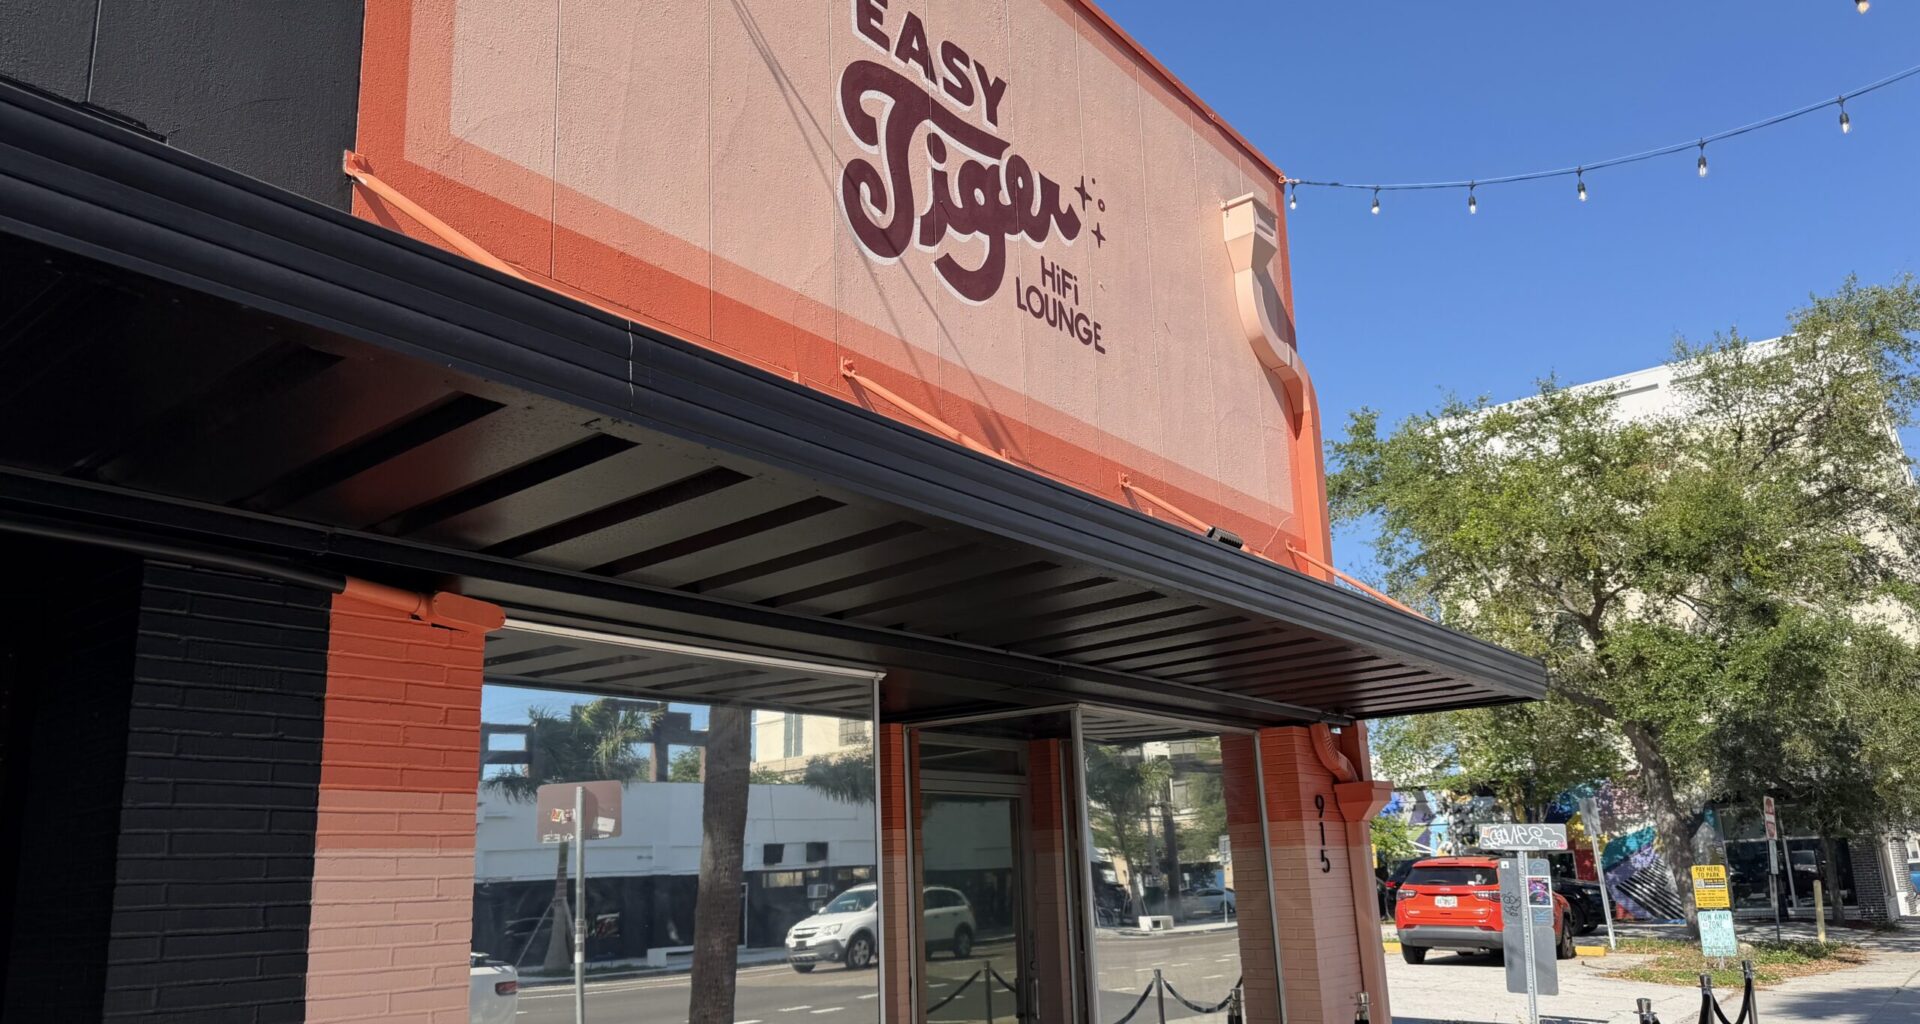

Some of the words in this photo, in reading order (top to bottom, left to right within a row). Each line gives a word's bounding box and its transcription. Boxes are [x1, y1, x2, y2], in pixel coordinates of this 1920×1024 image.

[855, 0, 1006, 128] EASY
[840, 60, 1081, 302] Tiger
[1016, 277, 1106, 355] LOUNGE
[1041, 255, 1079, 305] HiFi
[1315, 794, 1331, 873] 915
